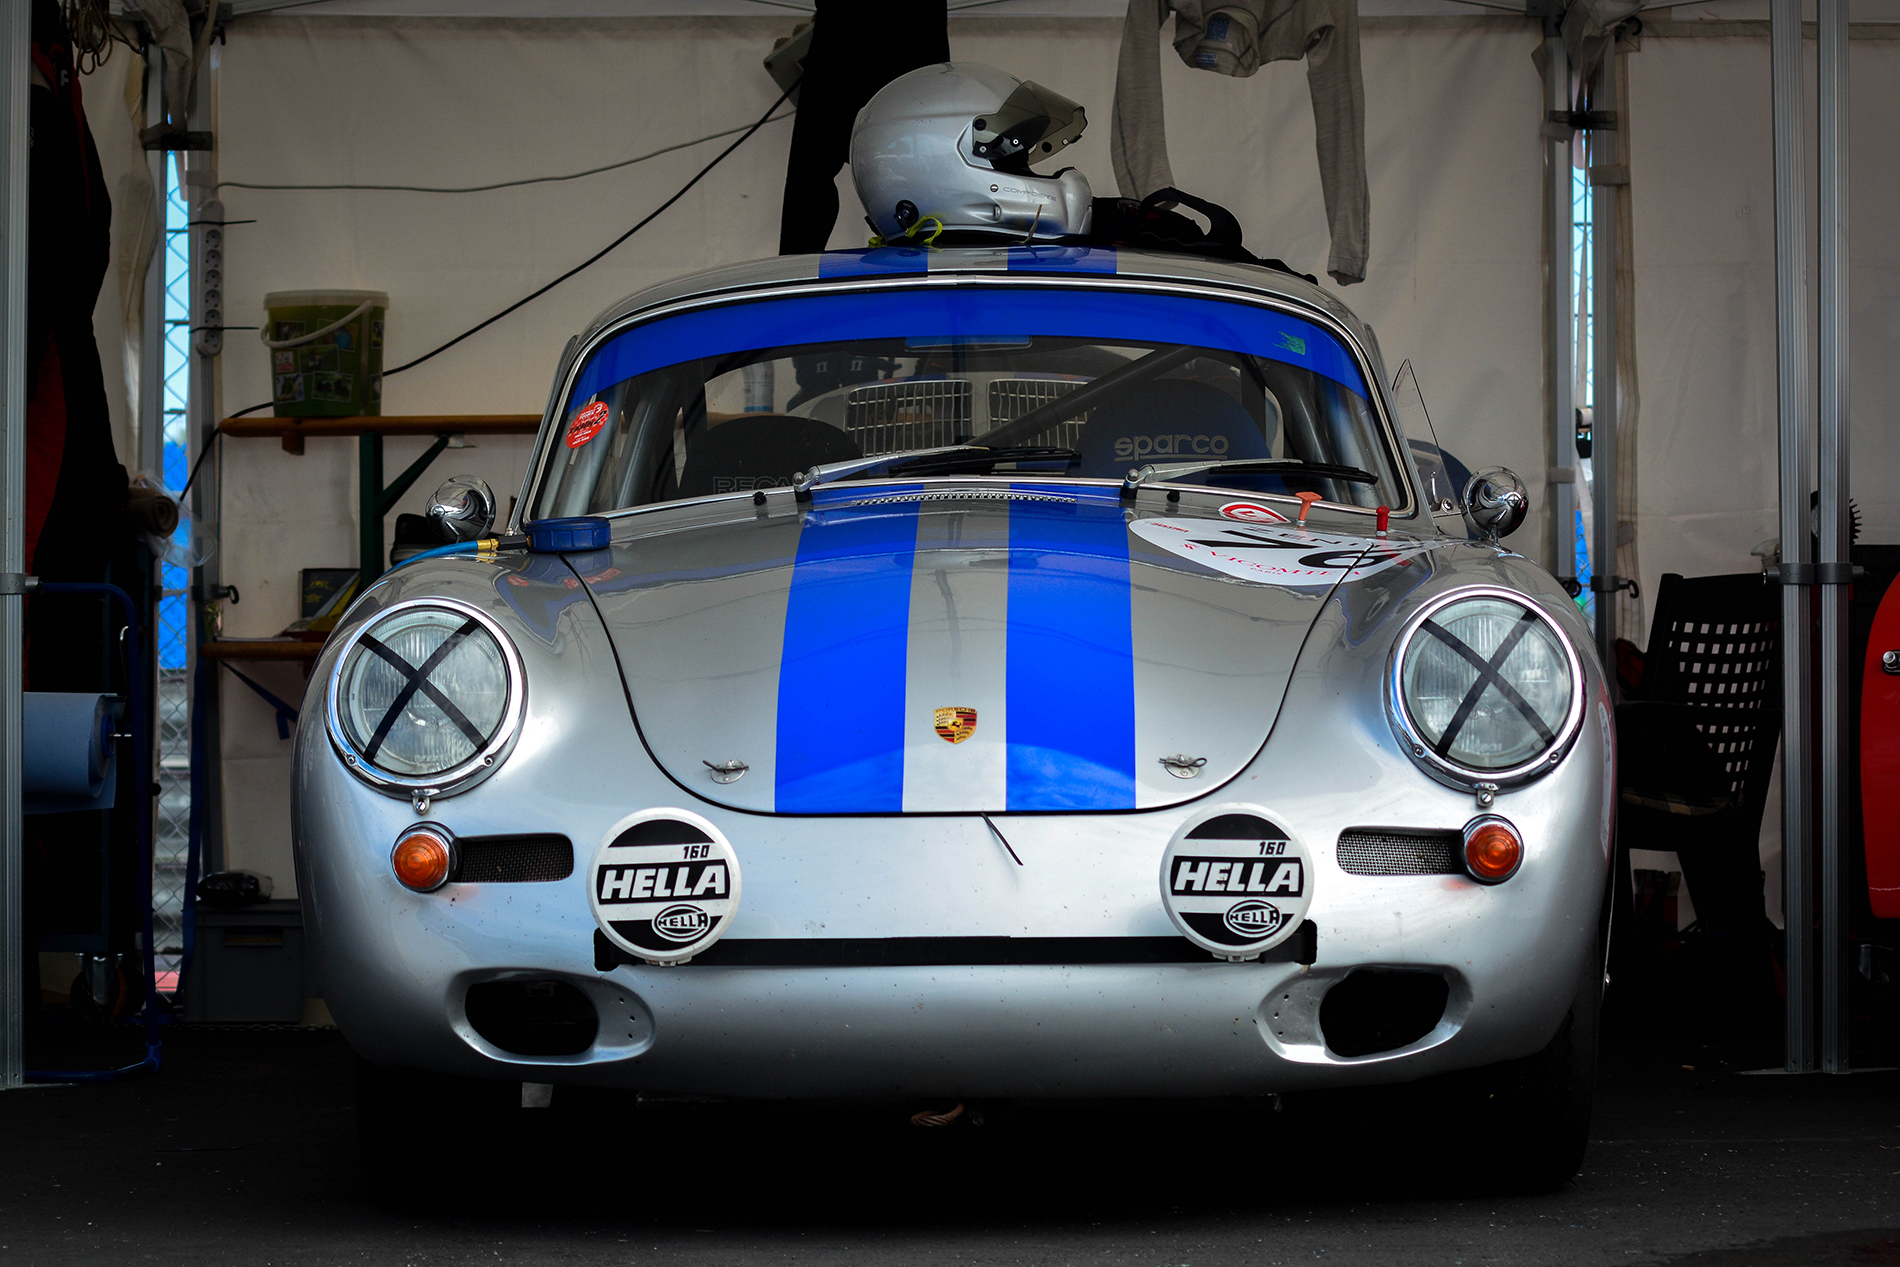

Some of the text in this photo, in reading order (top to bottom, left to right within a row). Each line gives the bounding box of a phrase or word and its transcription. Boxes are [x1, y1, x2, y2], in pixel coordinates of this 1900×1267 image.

[1114, 434, 1229, 461] sparco
[683, 844, 710, 859] 160
[1259, 841, 1287, 856] 160
[601, 864, 726, 900] HELLA
[1174, 861, 1300, 892] HELLA
[658, 912, 708, 928] HELLA
[1230, 910, 1280, 925] HELLA
